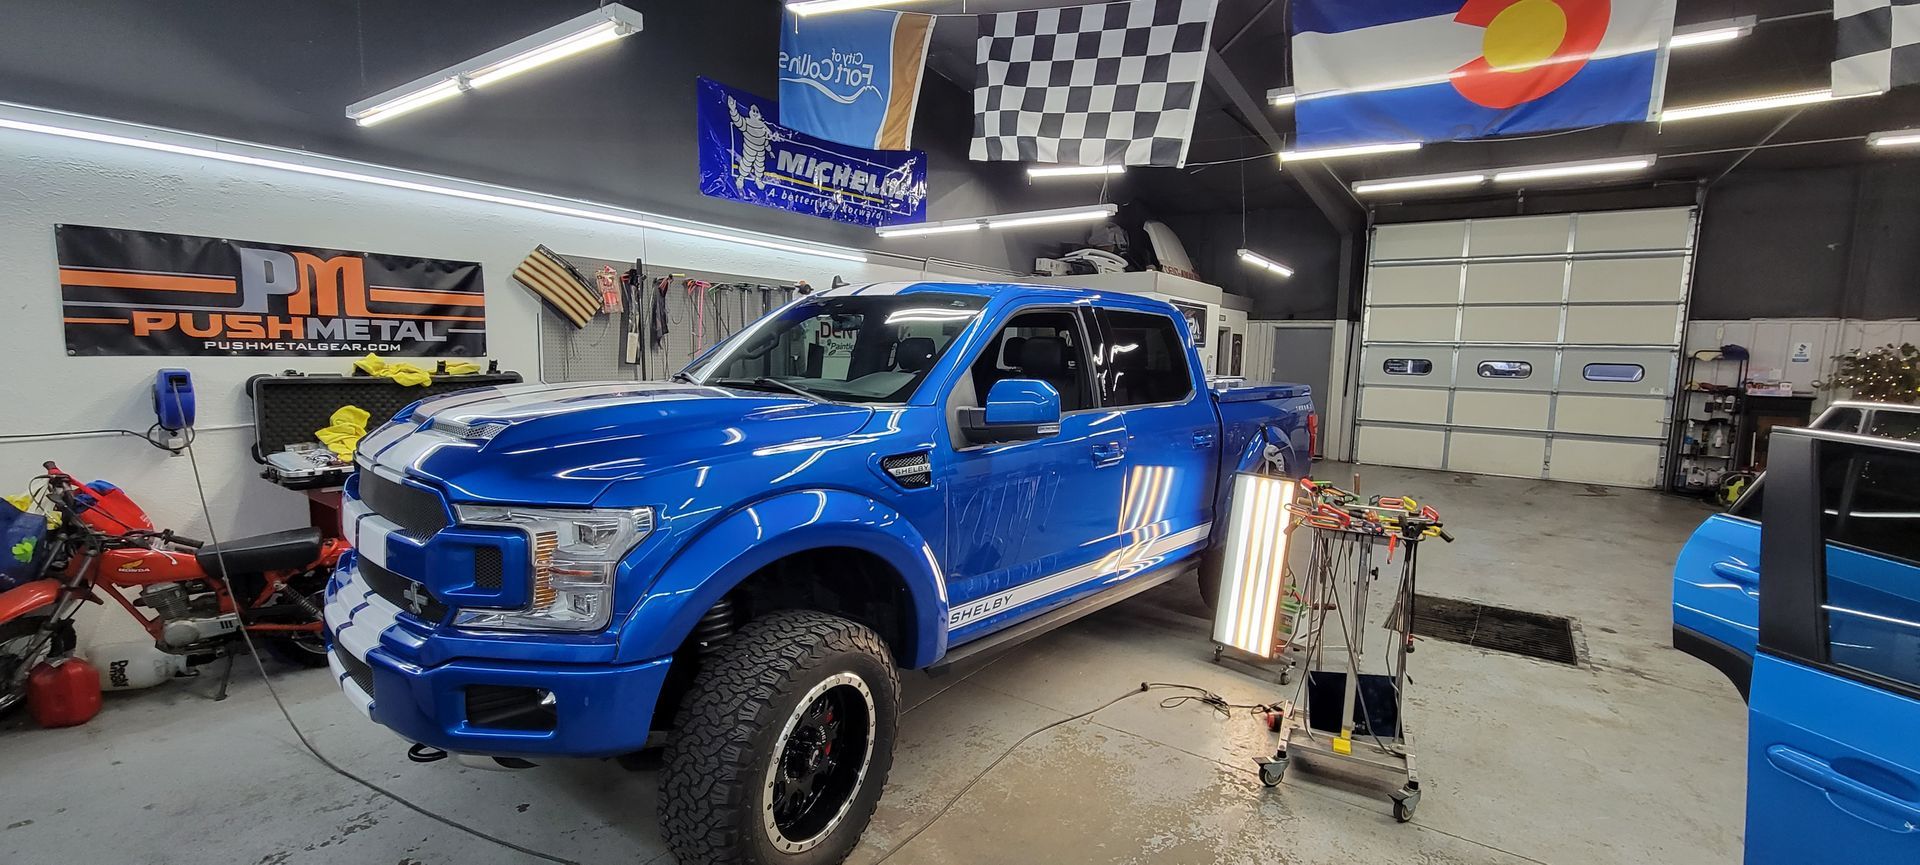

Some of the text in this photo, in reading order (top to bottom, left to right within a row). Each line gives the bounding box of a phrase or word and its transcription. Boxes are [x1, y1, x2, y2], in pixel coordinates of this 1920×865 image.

[768, 188, 776, 198] A
[781, 190, 815, 206] better
[238, 247, 370, 317] PM
[132, 310, 447, 342] PUSHMETAL
[204, 341, 401, 352] PUSHMETALGEAR.COM
[895, 465, 929, 476] SHELBY
[949, 593, 1013, 625] SHELBY
